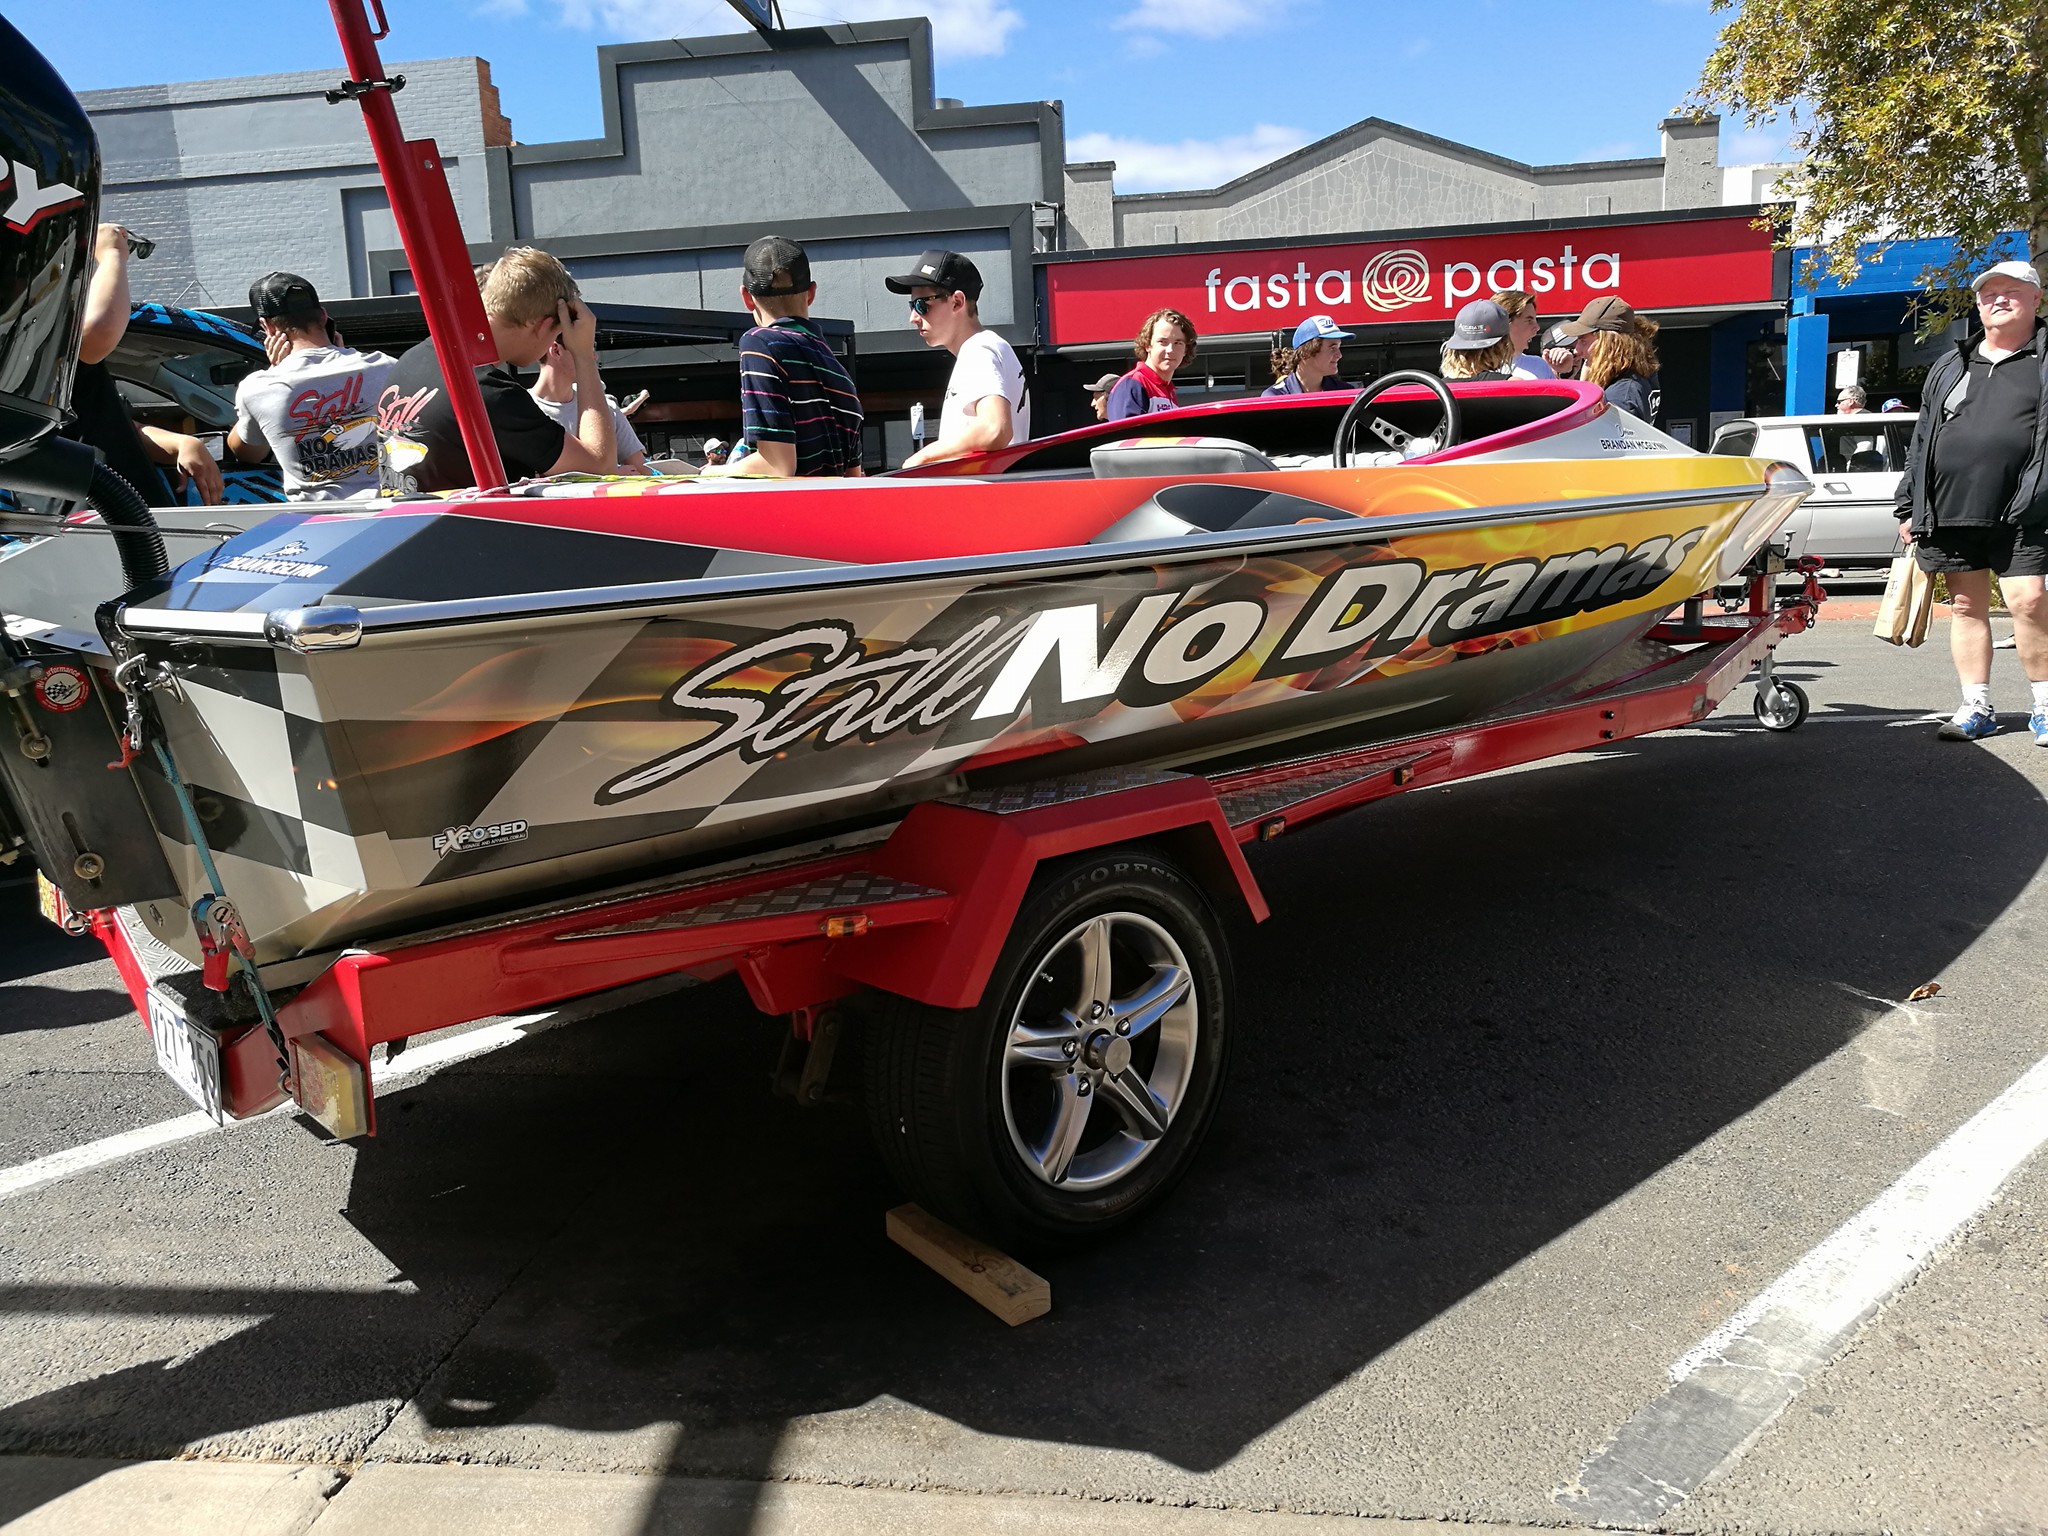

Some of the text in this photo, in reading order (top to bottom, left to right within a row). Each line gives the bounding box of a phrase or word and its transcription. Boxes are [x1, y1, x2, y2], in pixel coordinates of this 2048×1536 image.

[0, 154, 85, 226] Y
[1205, 245, 1620, 312] fasta pasta
[297, 436, 328, 459] NO
[300, 442, 379, 478] DRAMAS
[1600, 439, 1638, 450] BRANDAN
[608, 611, 1042, 797] Still
[1280, 526, 1706, 659] Dramas
